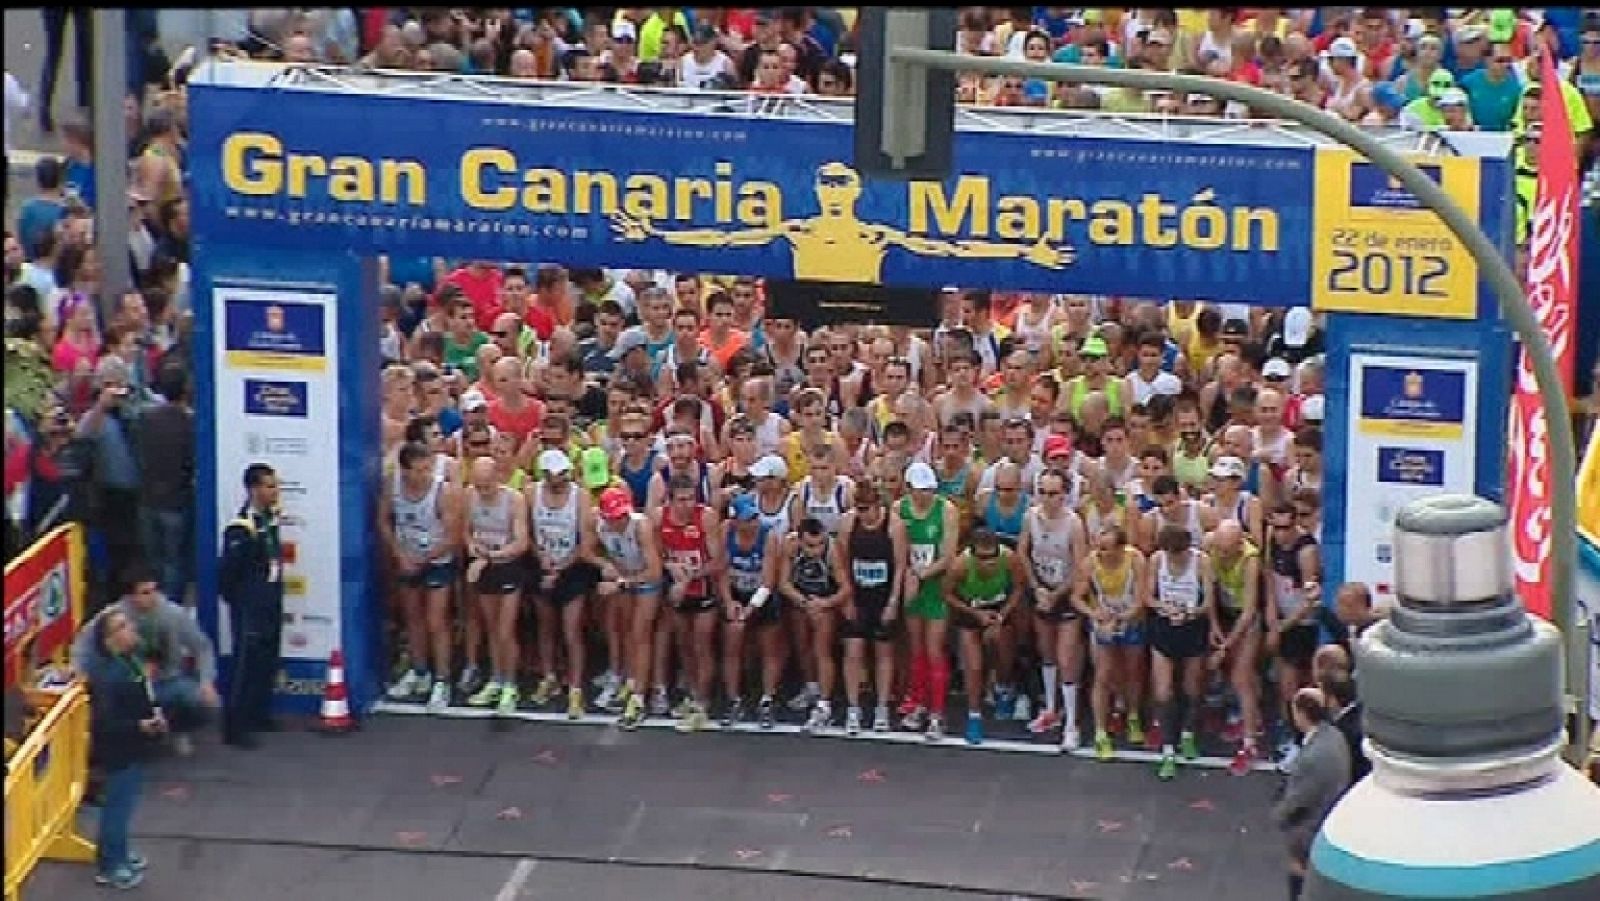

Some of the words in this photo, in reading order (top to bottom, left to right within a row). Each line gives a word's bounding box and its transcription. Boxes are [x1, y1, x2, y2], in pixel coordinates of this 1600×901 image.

[222, 132, 426, 206] Gran
[460, 147, 783, 226] Canaria
[907, 175, 1280, 252] Maratón
[225, 205, 589, 239] www.grancanariamaraton.com
[1332, 230, 1358, 247] 22
[1365, 231, 1388, 247] de
[1395, 236, 1452, 252] enero
[1328, 250, 1449, 297] 2012
